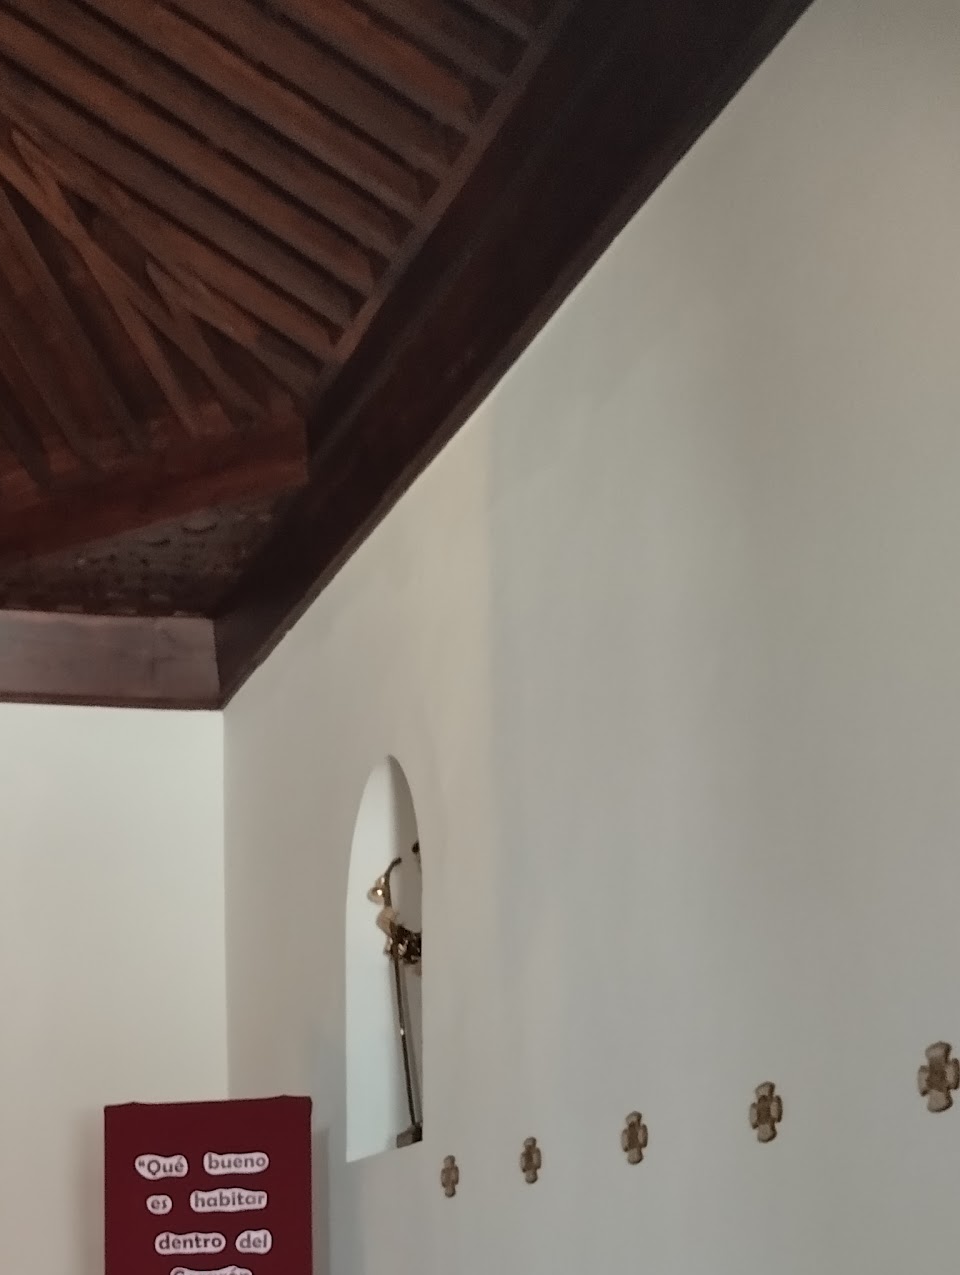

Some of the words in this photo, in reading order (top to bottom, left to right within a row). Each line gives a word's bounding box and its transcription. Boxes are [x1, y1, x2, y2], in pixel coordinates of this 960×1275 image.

[207, 1153, 267, 1170] bueno
[150, 1198, 168, 1210] es
[194, 1191, 266, 1208] habitar
[158, 1233, 223, 1250] dentro
[239, 1232, 268, 1249] del
